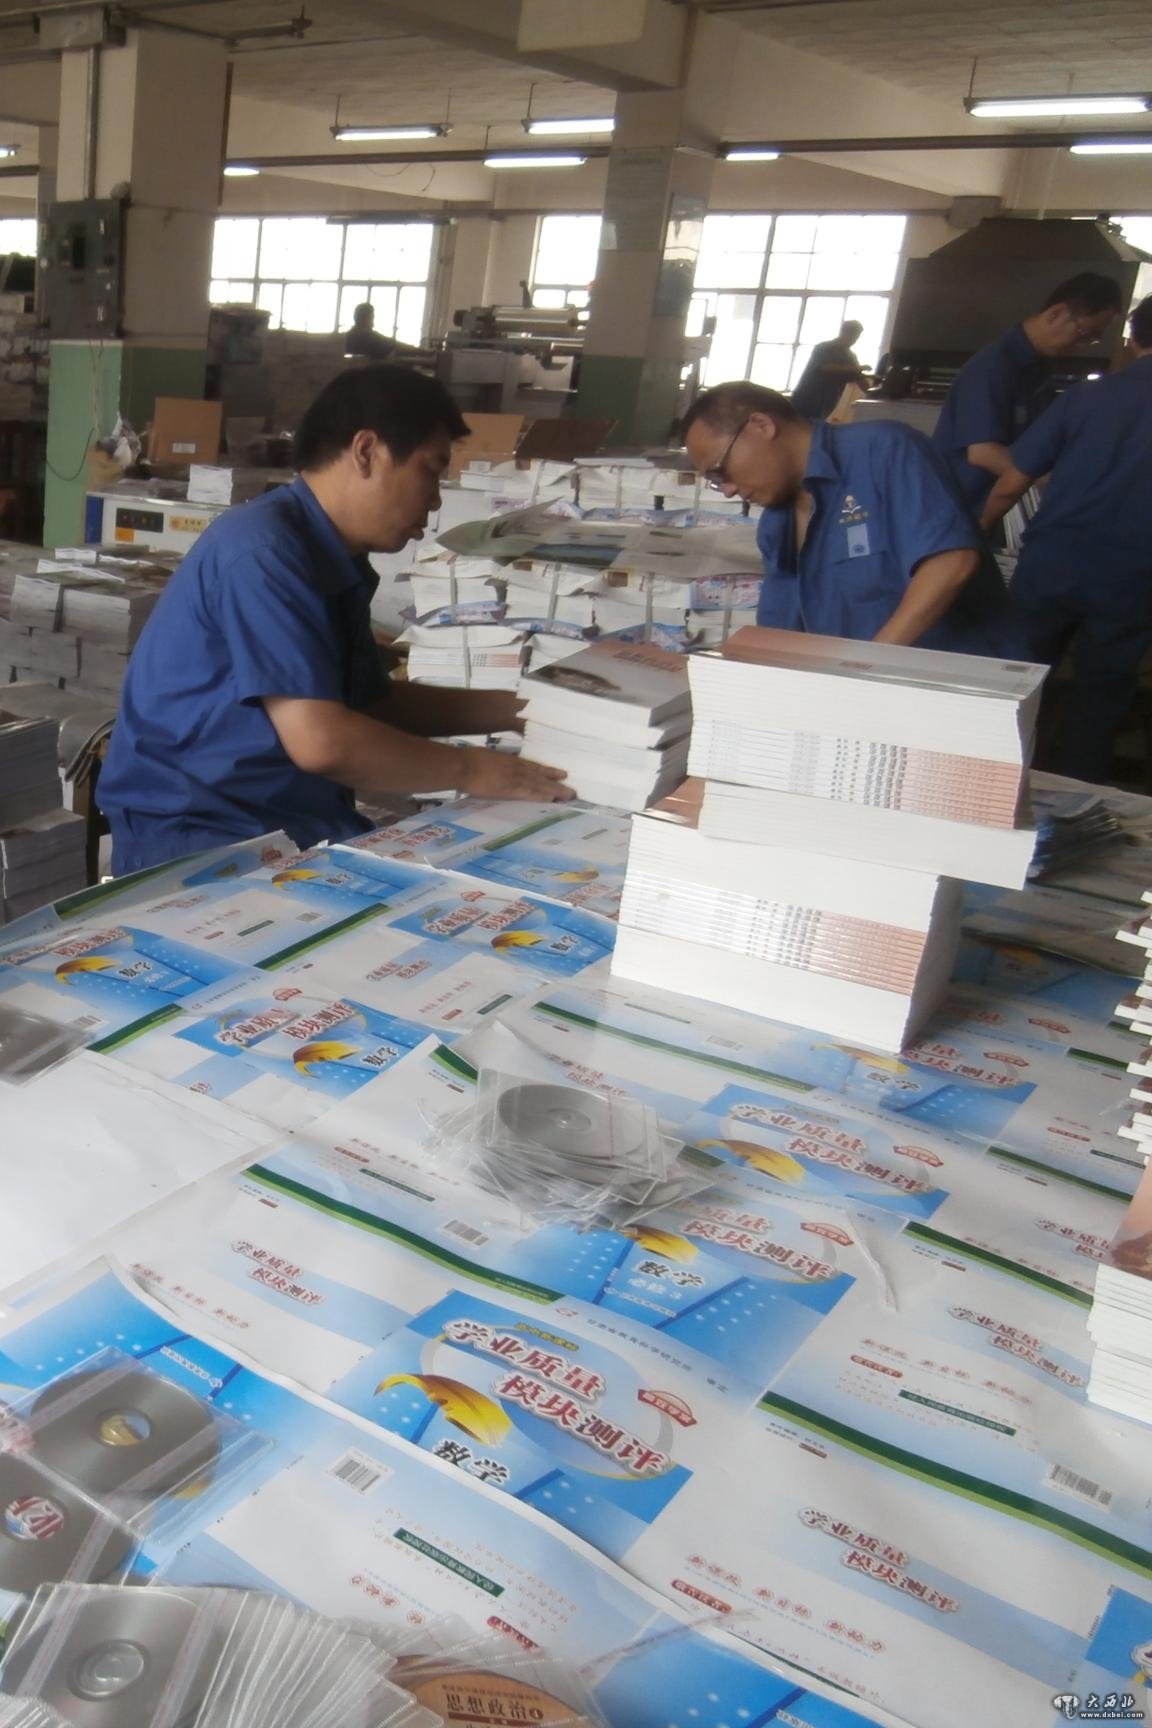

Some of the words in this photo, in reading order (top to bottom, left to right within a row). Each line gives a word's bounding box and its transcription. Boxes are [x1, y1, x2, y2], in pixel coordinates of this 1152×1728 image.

[736, 1104, 866, 1152] 学业质量
[788, 1137, 929, 1193] 模块测评
[637, 1260, 704, 1287] 数学
[684, 1220, 835, 1281] 模块测评
[951, 1306, 1042, 1349] 学业质量
[450, 1319, 604, 1398] 学业质量
[992, 1335, 1085, 1387] 模块测评
[498, 1373, 667, 1472] 模块测评
[434, 1440, 509, 1485] 数学
[803, 1509, 910, 1568] 学业质量
[846, 1550, 958, 1612] 模块测评
[446, 1692, 527, 1720] 思想政治
